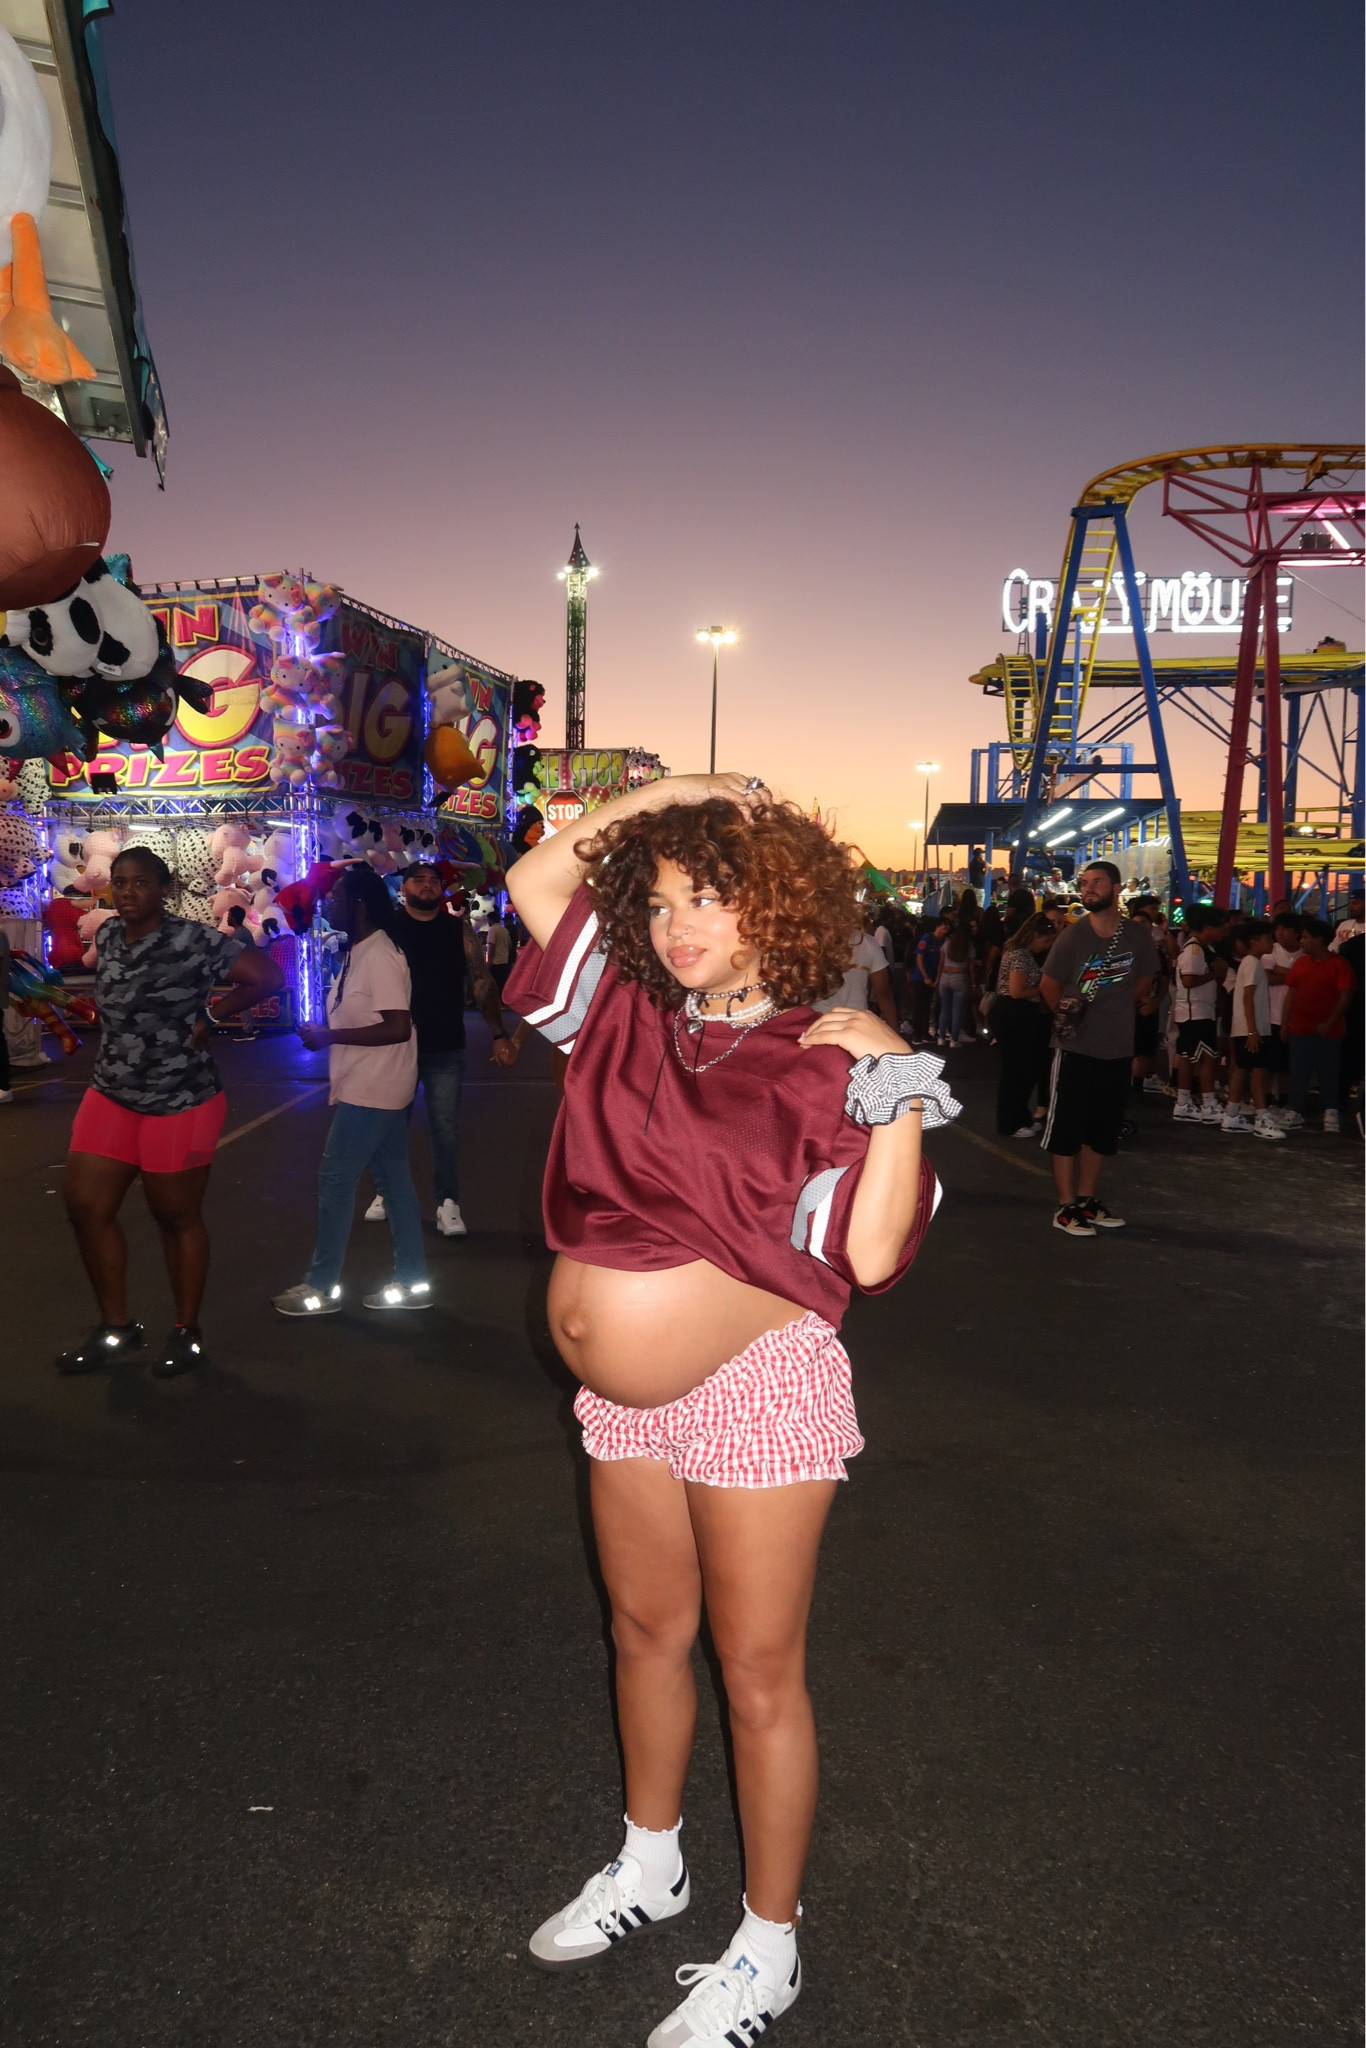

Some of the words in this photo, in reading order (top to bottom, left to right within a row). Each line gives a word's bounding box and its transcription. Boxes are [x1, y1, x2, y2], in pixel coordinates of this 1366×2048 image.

[340, 620, 399, 673] WIN
[571, 751, 624, 789] STOP
[547, 804, 584, 821] STOP
